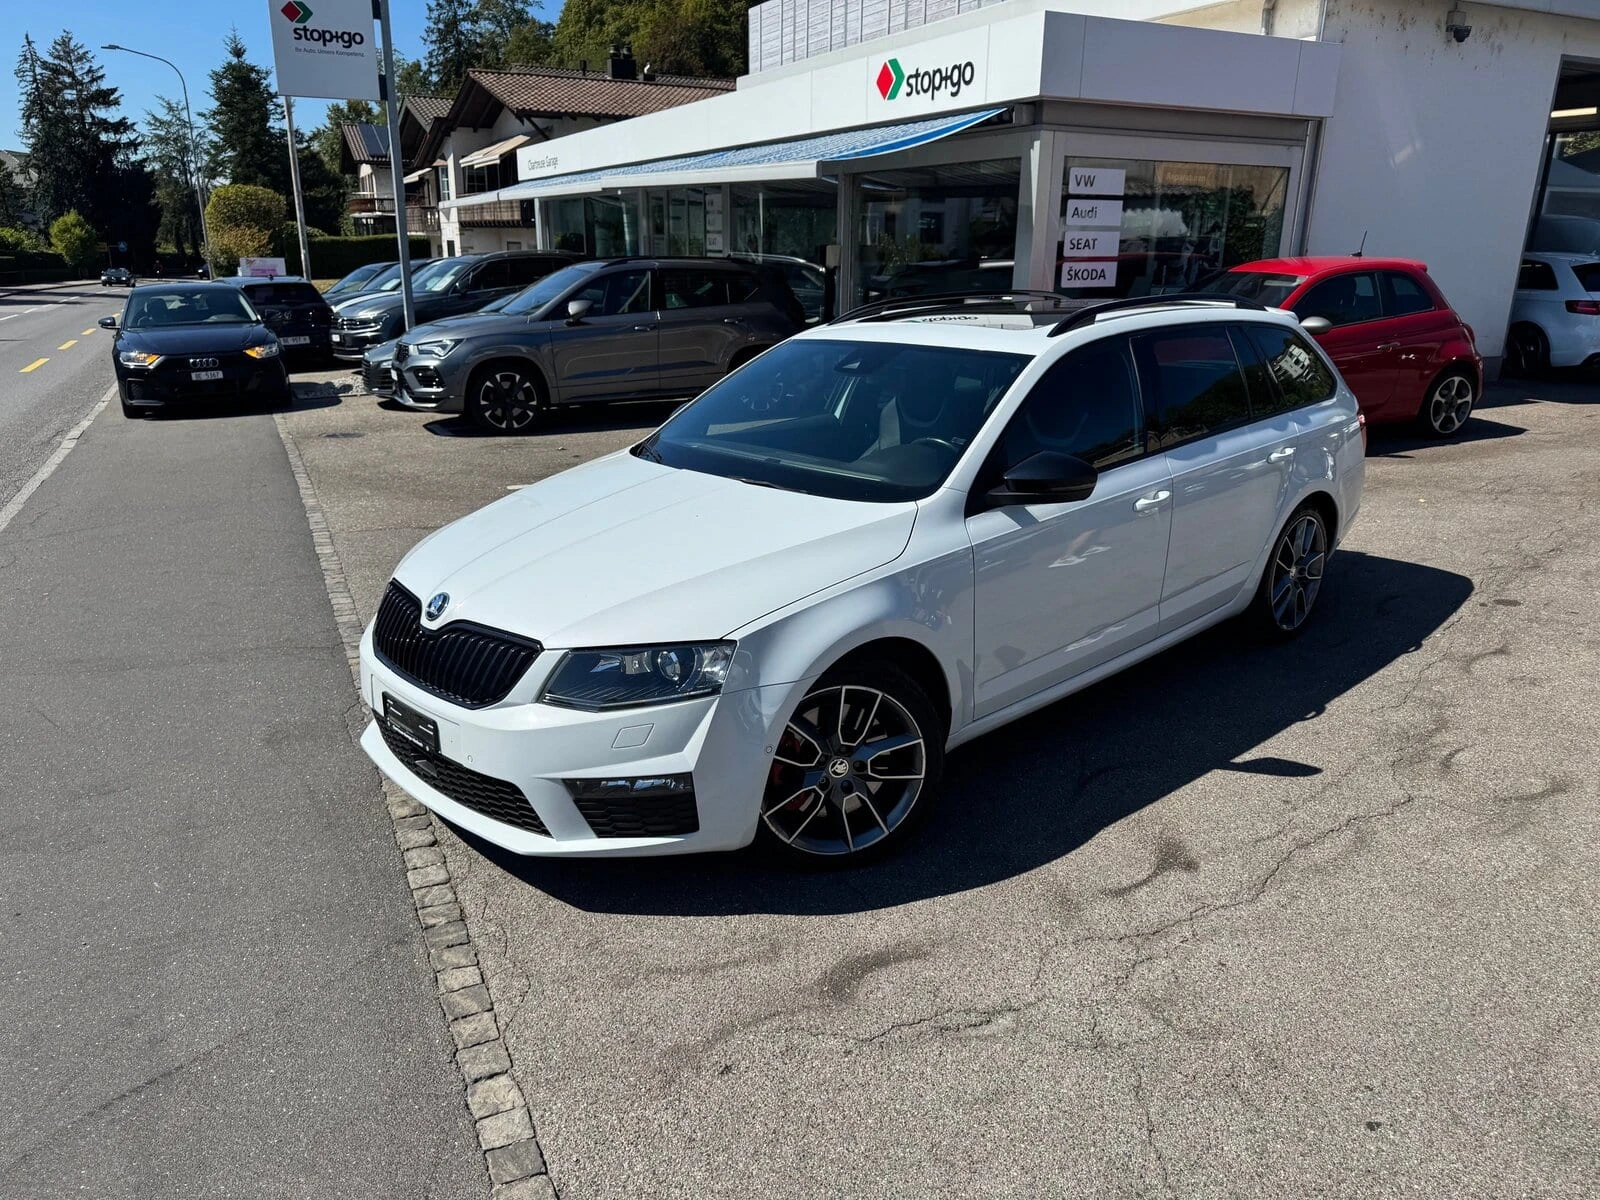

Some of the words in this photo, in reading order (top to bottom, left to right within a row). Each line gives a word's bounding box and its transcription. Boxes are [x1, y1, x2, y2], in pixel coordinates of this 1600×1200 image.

[293, 25, 364, 48] stop+go
[906, 61, 975, 101] stop+go
[1074, 174, 1096, 187] VW
[1071, 206, 1098, 219] Audi
[1069, 238, 1098, 250] SEAT
[1066, 266, 1107, 281] ŠKODA
